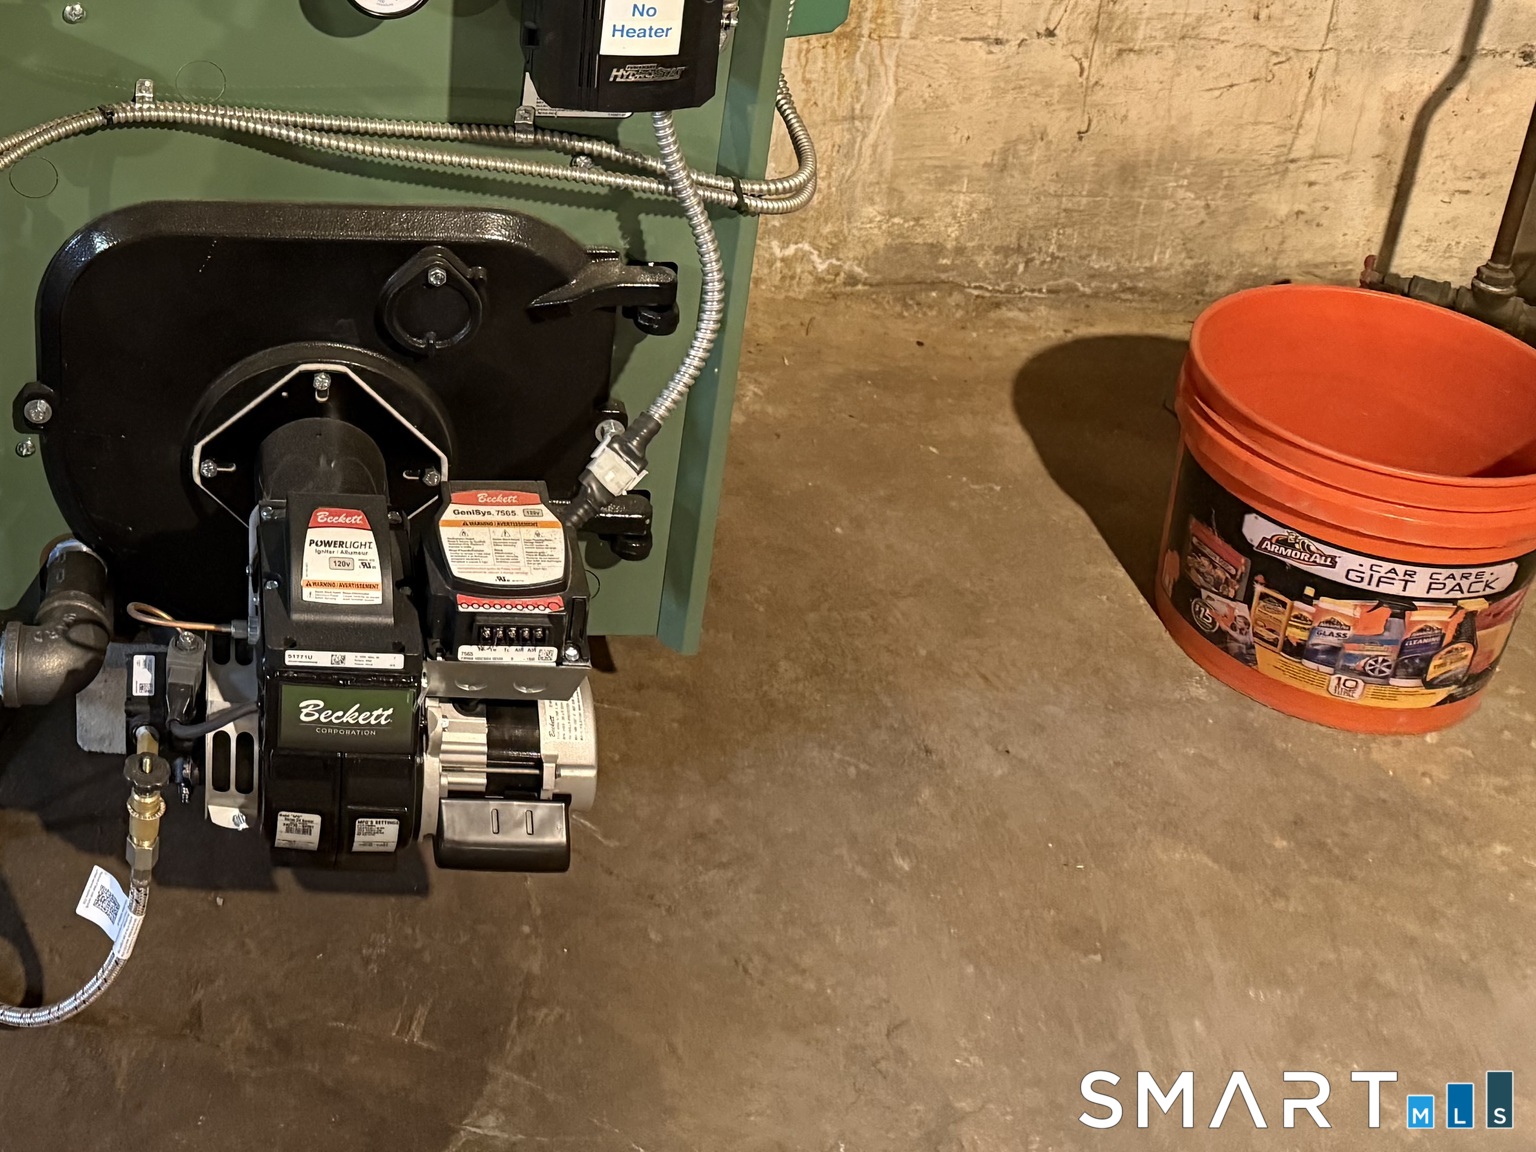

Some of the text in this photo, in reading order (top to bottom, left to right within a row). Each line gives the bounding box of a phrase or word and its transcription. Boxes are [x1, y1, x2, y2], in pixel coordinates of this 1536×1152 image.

[631, 4, 657, 18] No
[611, 24, 673, 38] Heater
[477, 493, 518, 503] Beckett
[316, 511, 364, 524] Beckett
[453, 509, 492, 517] GeniSys
[309, 539, 373, 549] POWERLIGHT
[333, 560, 351, 568] 120v
[1369, 563, 1485, 581] CAR CARE
[1345, 569, 1500, 595] GIFT PACK
[1316, 630, 1348, 639] GLASS
[1405, 636, 1441, 647] CLEANING
[1336, 676, 1358, 689] 10
[299, 699, 394, 725] Beckett
